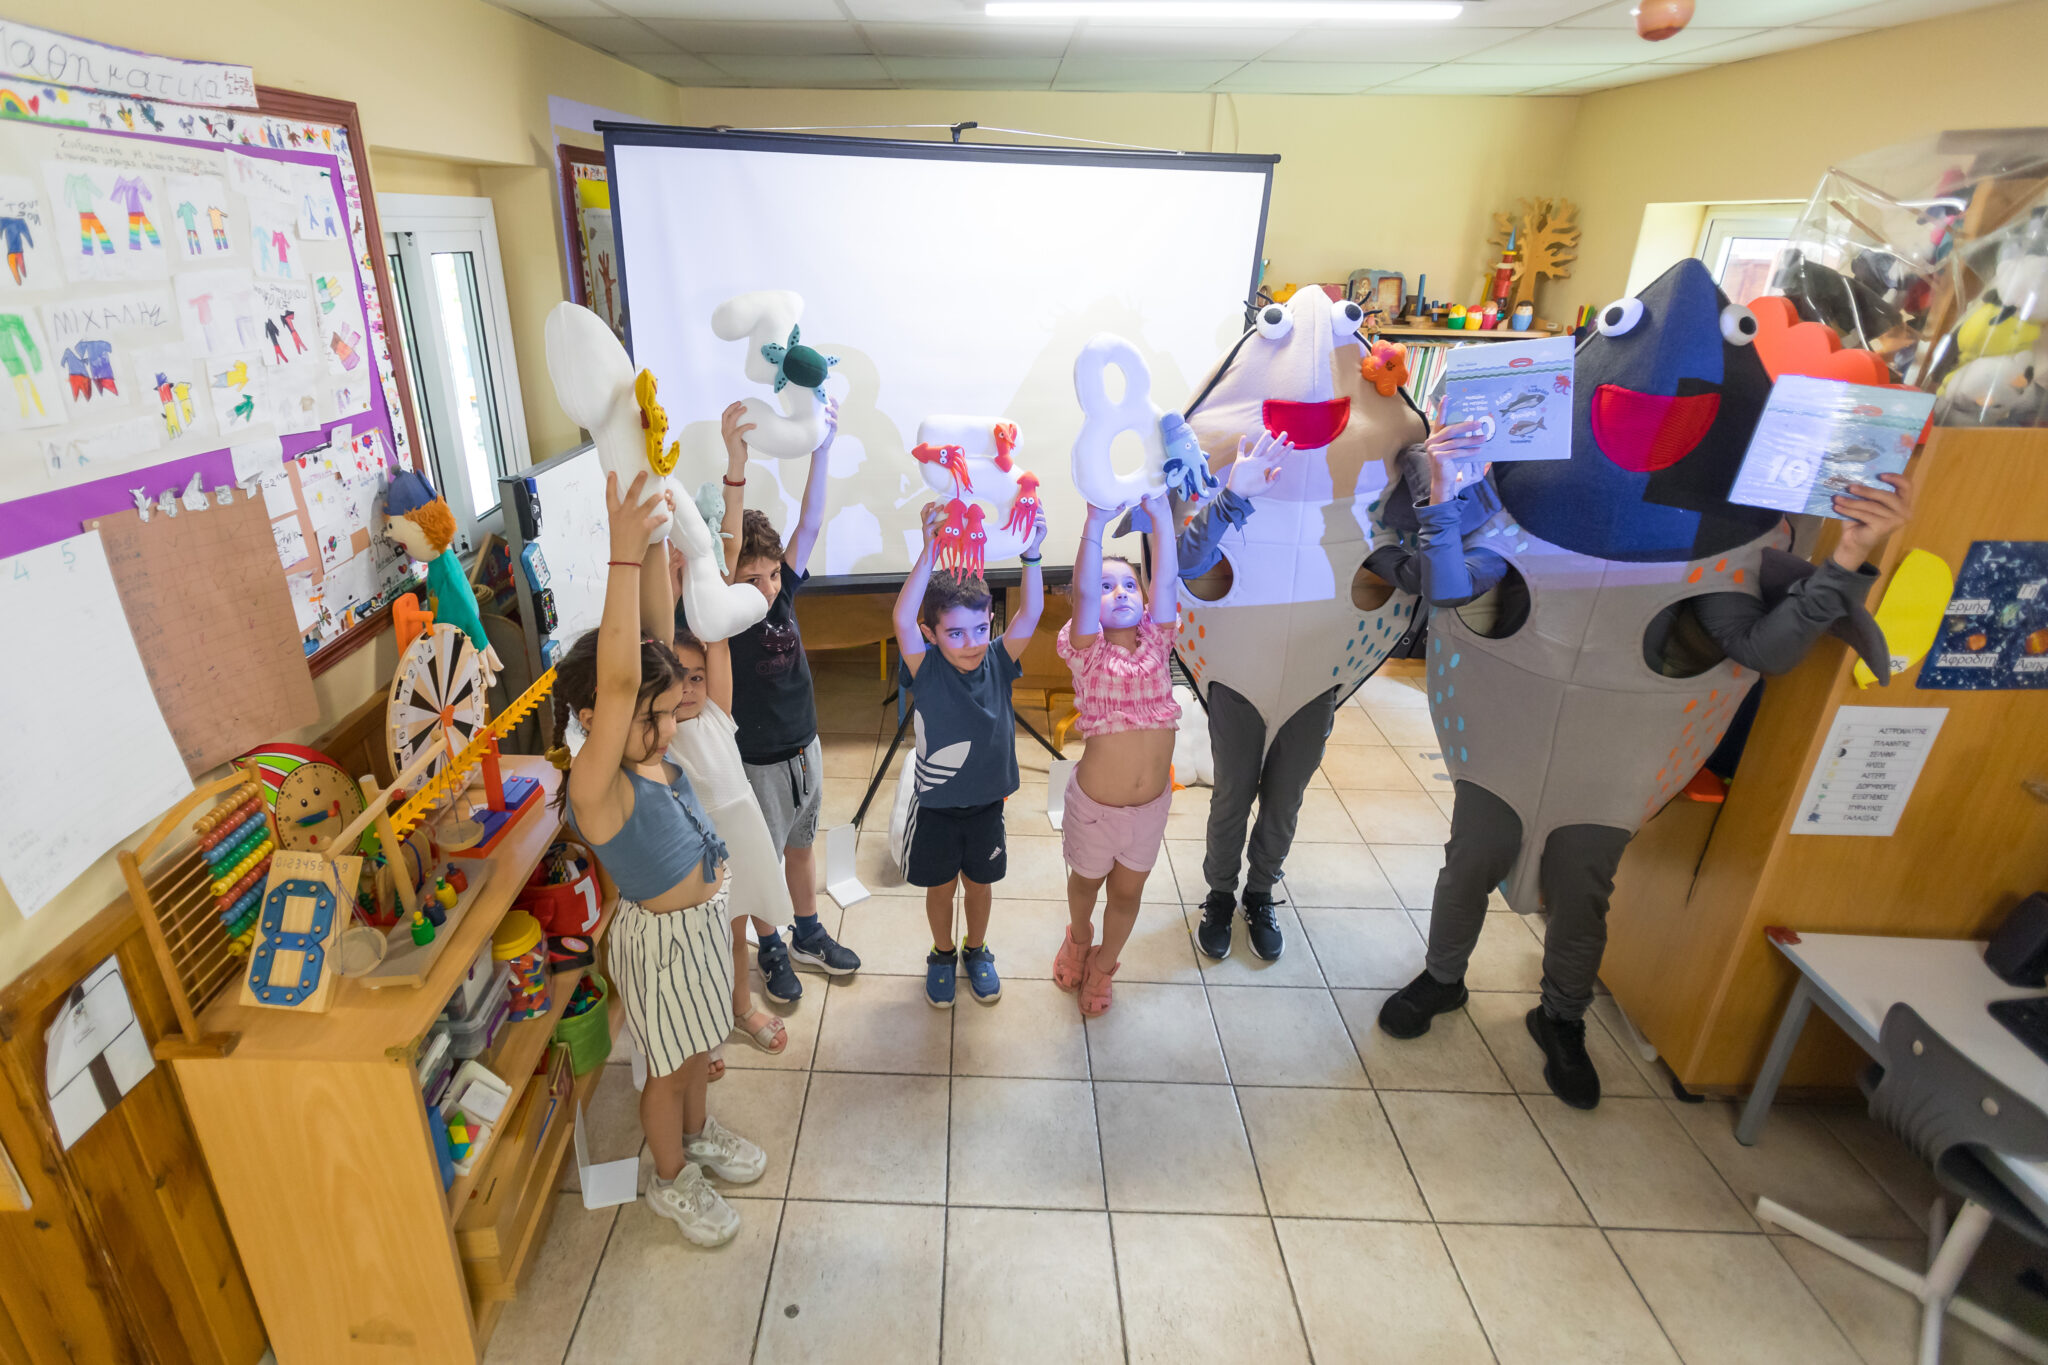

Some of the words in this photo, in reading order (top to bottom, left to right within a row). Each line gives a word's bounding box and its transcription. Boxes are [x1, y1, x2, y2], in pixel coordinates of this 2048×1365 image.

[0, 27, 223, 98] αθηματικά
[60, 541, 76, 565] 5
[574, 876, 601, 933] 1
